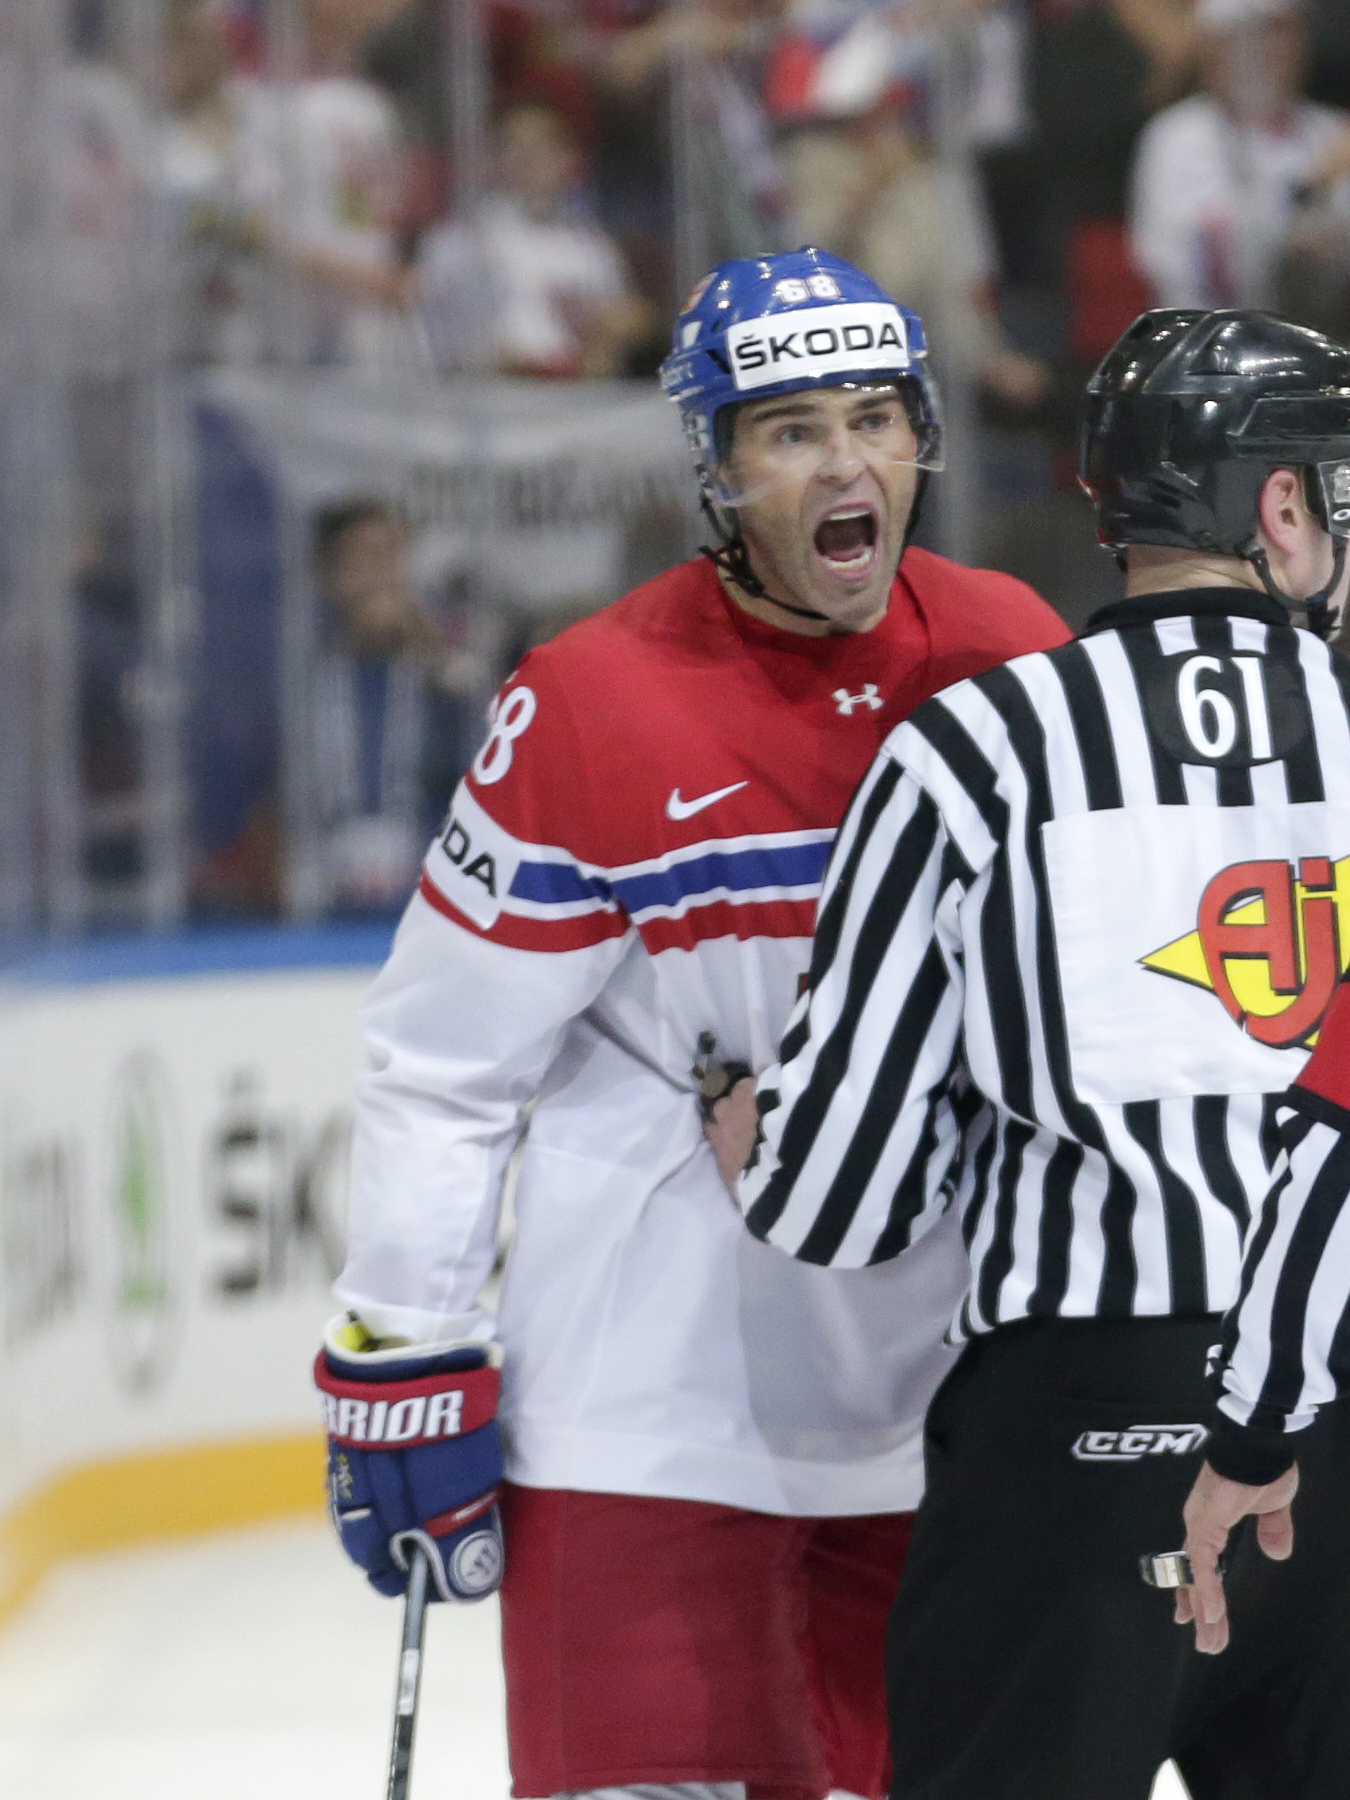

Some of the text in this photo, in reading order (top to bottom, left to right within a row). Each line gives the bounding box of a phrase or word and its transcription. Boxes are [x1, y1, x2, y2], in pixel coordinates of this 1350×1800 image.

[773, 274, 841, 304] 68
[735, 322, 905, 371] ŠKODA
[473, 670, 538, 786] 8
[1177, 655, 1273, 759] 61
[438, 818, 497, 898] DA
[1083, 1430, 1196, 1455] CCM
